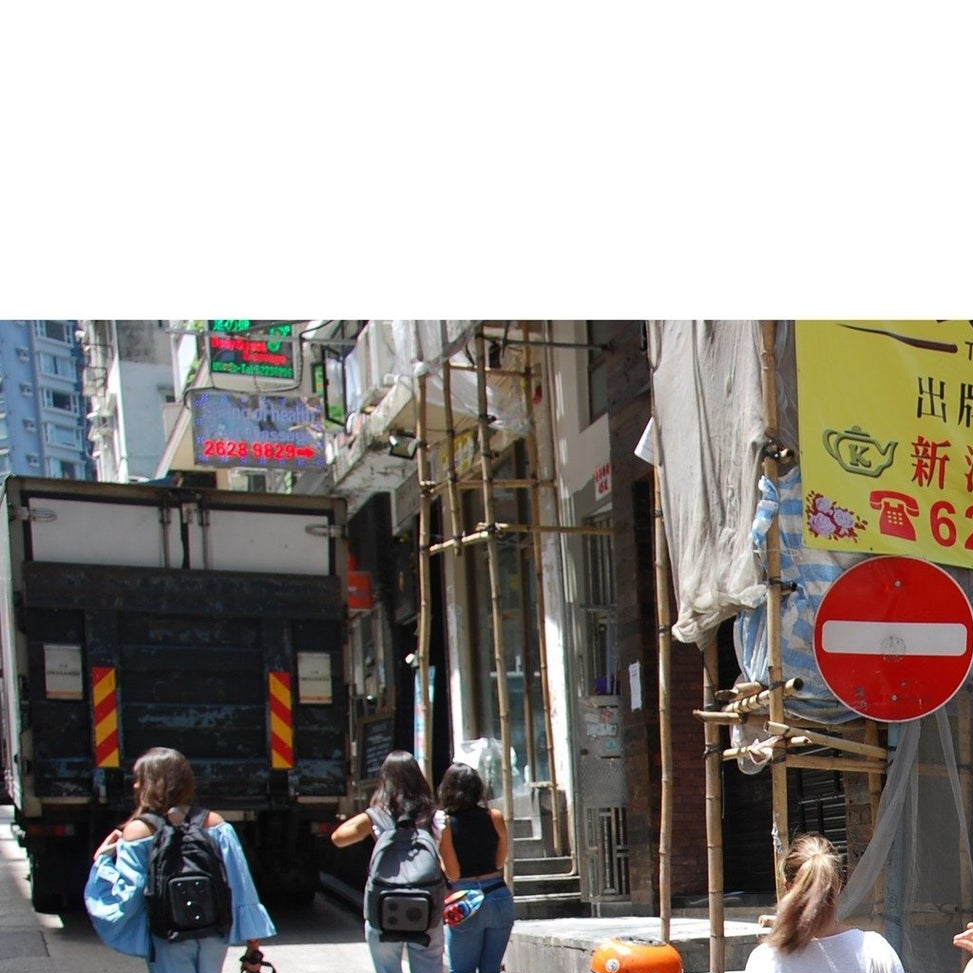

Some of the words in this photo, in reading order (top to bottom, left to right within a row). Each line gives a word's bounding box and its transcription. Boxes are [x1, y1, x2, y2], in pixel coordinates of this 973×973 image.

[204, 441, 248, 458] 2628
[252, 443, 296, 460] 9829
[848, 444, 872, 468] K
